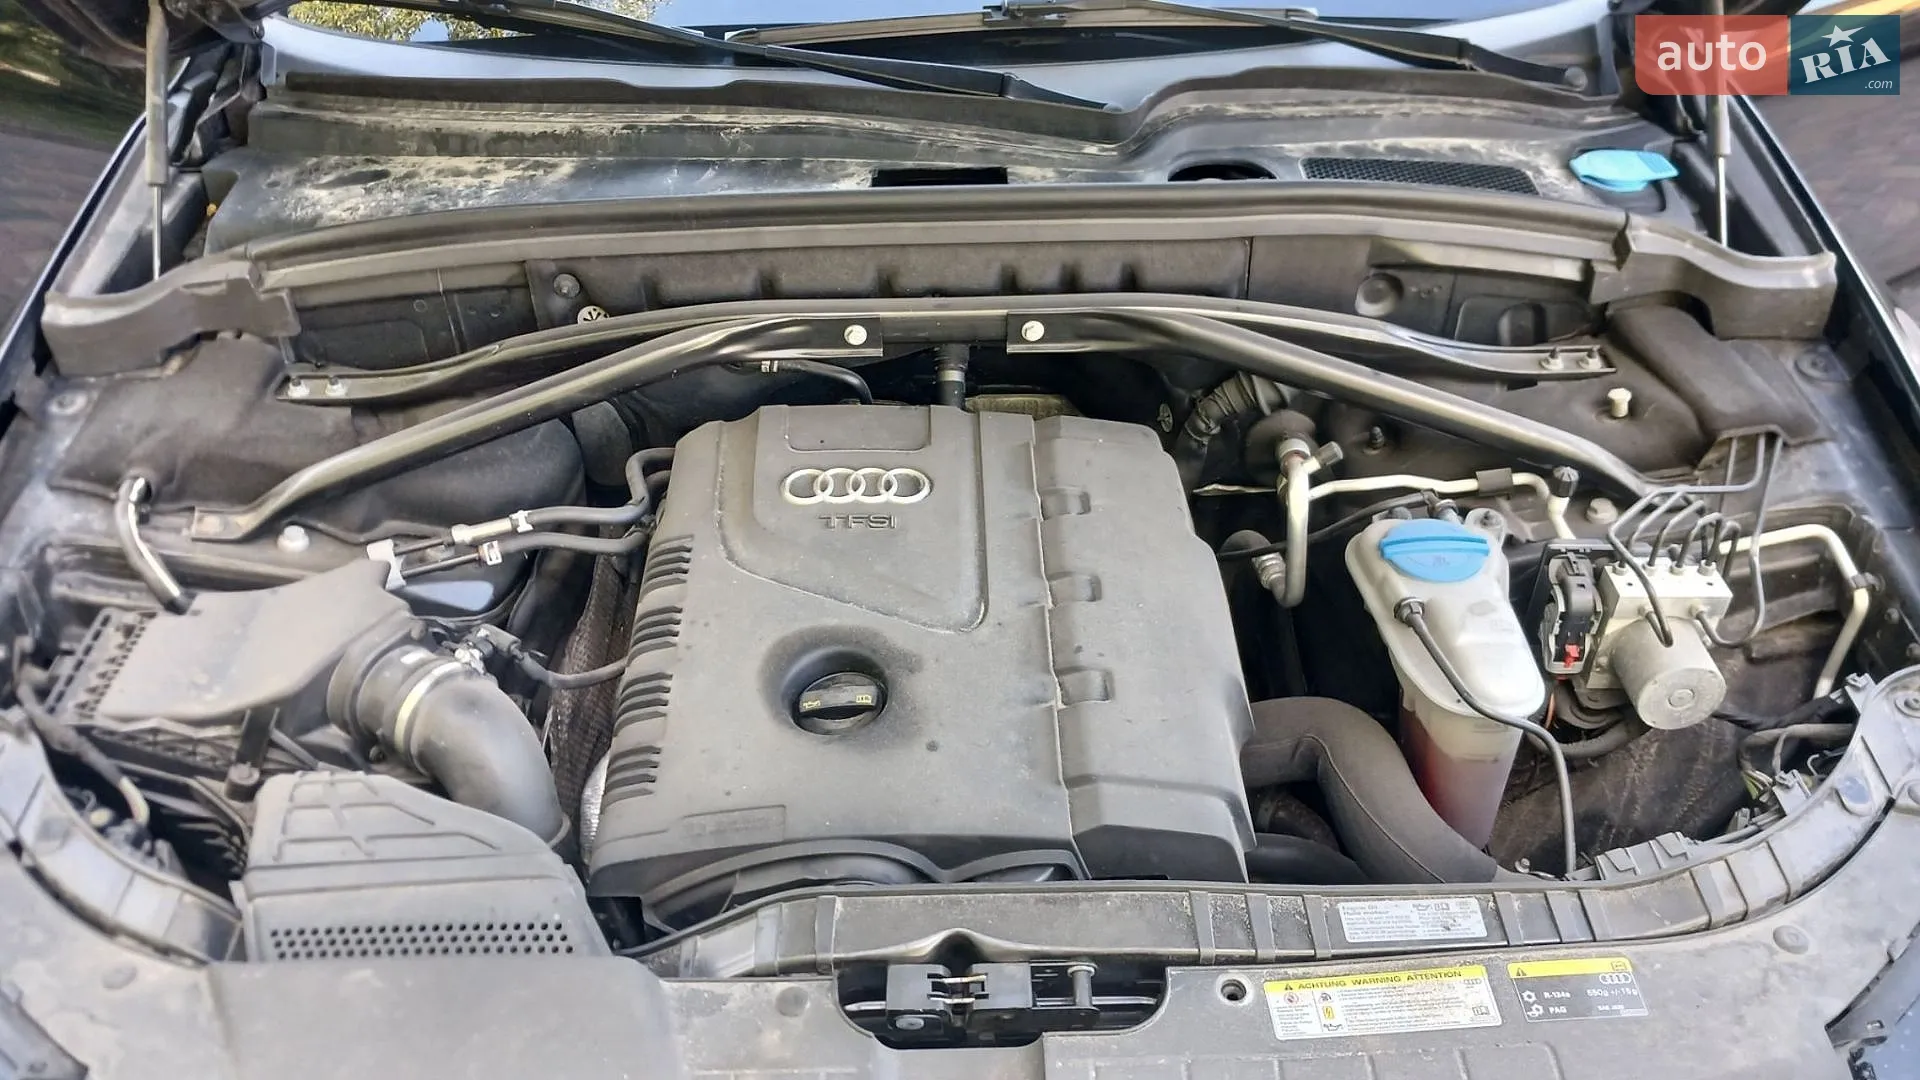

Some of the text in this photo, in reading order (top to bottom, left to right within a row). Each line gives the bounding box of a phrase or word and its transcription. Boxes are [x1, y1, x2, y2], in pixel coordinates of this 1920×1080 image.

[818, 514, 897, 531] TFSI
[1298, 970, 1462, 990] ACHTUNG WARNING ATTENTION
